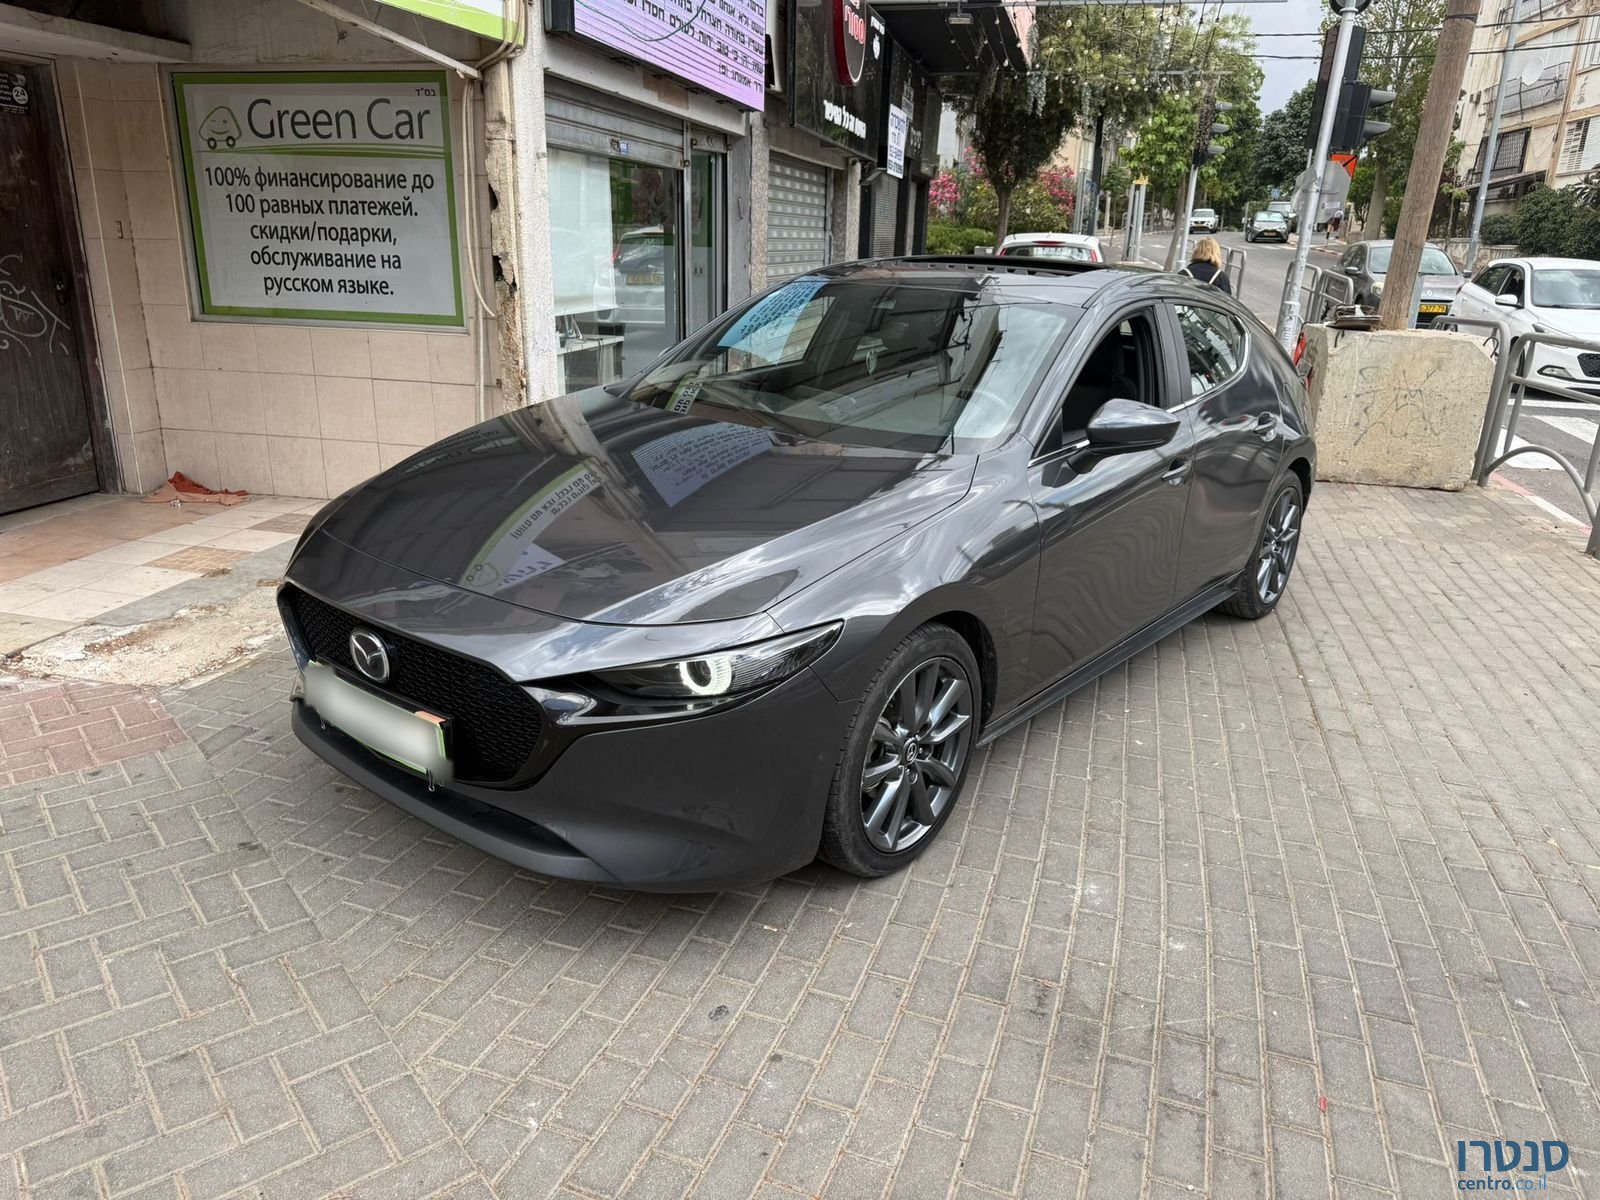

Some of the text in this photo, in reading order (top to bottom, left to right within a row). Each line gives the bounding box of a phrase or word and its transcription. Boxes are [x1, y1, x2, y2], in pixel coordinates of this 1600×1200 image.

[14, 88, 26, 98] 24
[415, 88, 436, 97] בס"ד
[247, 98, 431, 140] Green Car
[205, 166, 434, 193] 100% финансирование до
[225, 194, 418, 218] 100 равных платежей.
[250, 221, 397, 247] скидки/подарки,
[250, 246, 402, 271] обслуживание на
[263, 275, 394, 296] русском языке.
